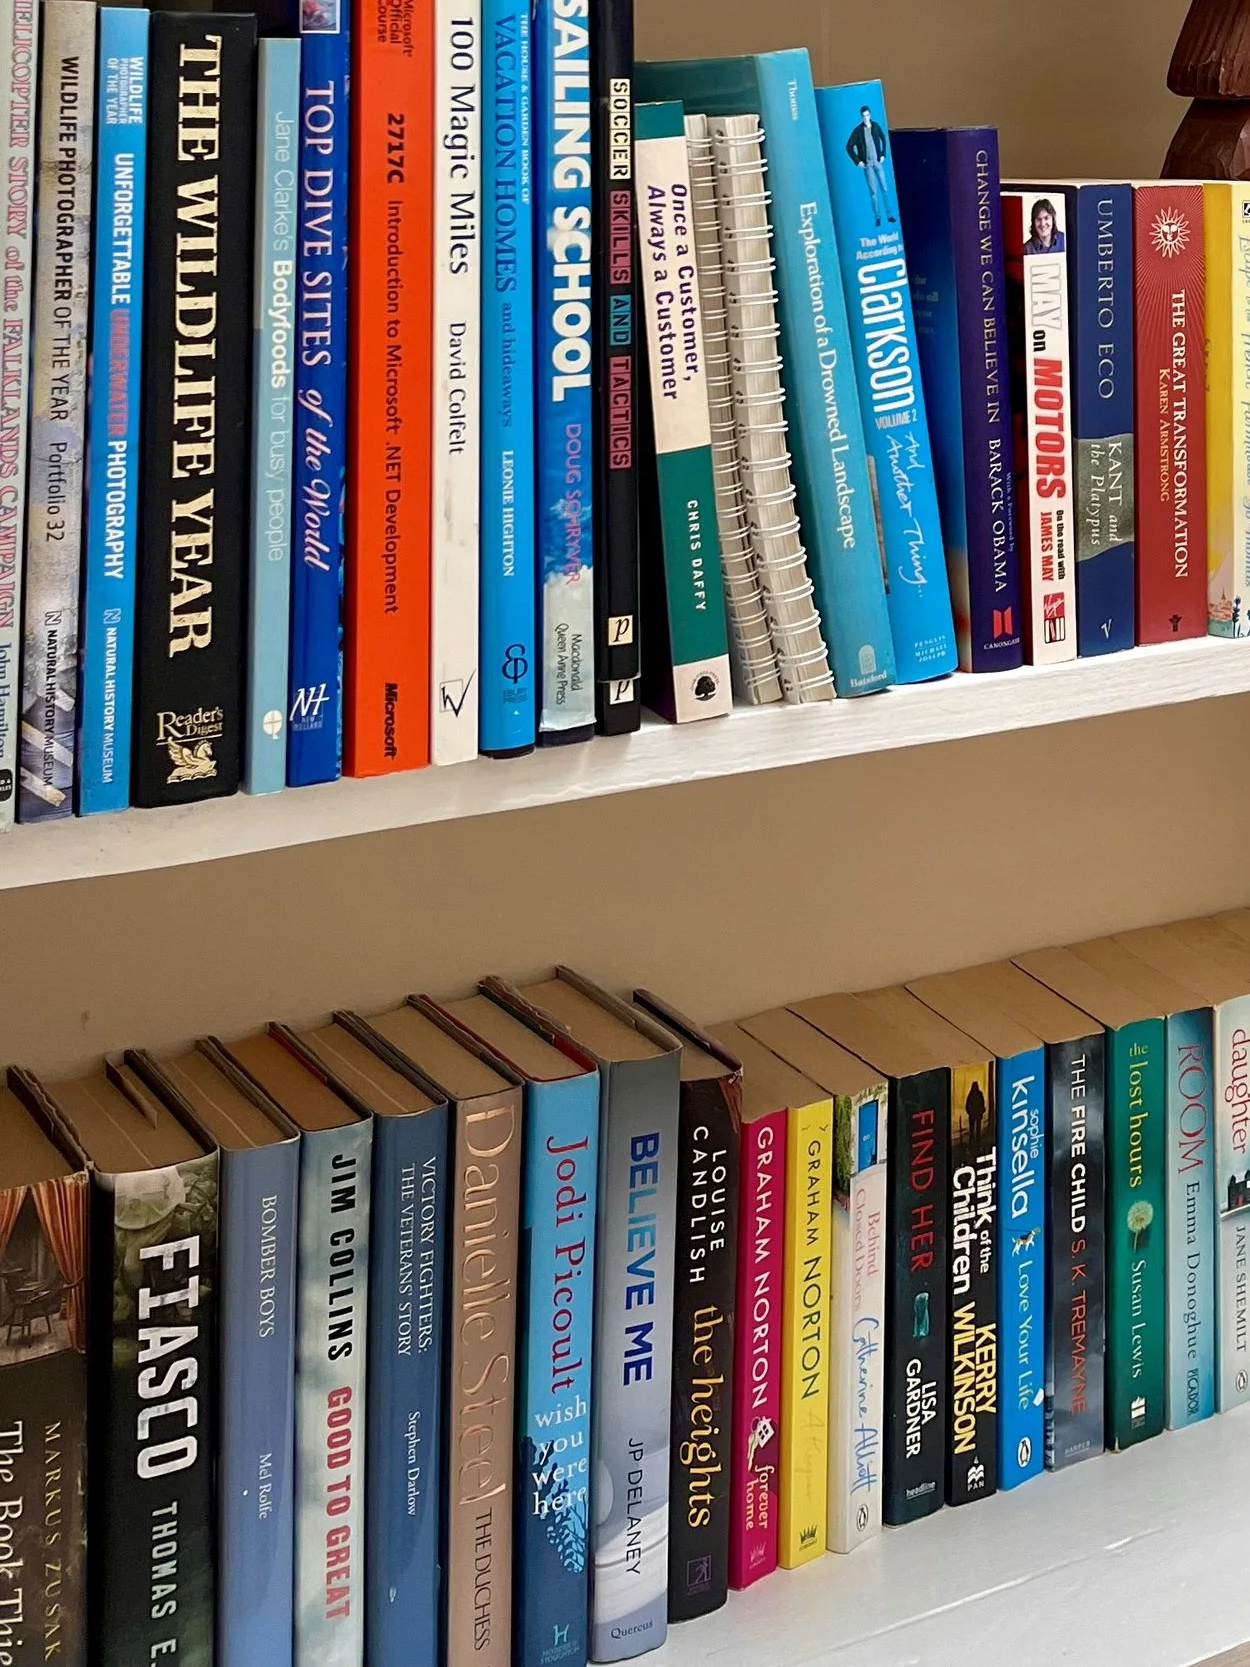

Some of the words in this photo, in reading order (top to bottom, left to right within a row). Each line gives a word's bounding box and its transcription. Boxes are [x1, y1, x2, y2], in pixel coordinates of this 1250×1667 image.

[449, 15, 475, 72] 100
[59, 56, 80, 143] WILDLIFE
[177, 34, 223, 162] THE
[303, 80, 334, 156] TOP
[443, 84, 476, 180] Magic
[611, 79, 630, 179] SOCCER
[385, 111, 406, 185] 2717C
[54, 147, 78, 302] PHOTOGRAPHER
[111, 152, 134, 305] UNFORGETTABLE
[302, 167, 333, 257] DIVE
[448, 191, 477, 275] Miles
[610, 192, 631, 283] SKILLS
[385, 199, 405, 314] Introduction
[1096, 198, 1116, 332] UMBERTO
[172, 173, 219, 480] WILDLIFE
[300, 270, 332, 368] SITES
[385, 315, 401, 337] to
[552, 204, 593, 403] SCHOOL
[610, 297, 631, 346] AND
[857, 258, 916, 413] Clarkson
[1171, 288, 1187, 330] THE
[385, 338, 403, 433] Microsoft
[1098, 341, 1116, 400] ECO
[1171, 331, 1187, 397] GREAT
[610, 356, 631, 468] TACTICS
[48, 440, 67, 513] Portfolio
[384, 439, 402, 485] .NET
[988, 438, 1005, 518] BARACK
[1171, 396, 1190, 580] TRANSFORMATION
[46, 518, 65, 542] 32
[105, 439, 127, 579] PHOTOGRAPHY
[381, 487, 401, 615] Development
[687, 499, 701, 550] CHRIS
[168, 487, 216, 659] YEAR
[690, 557, 707, 611] DAFFY
[991, 519, 1007, 593] OBAMA
[156, 707, 225, 742] Reader's
[185, 721, 224, 738] Digest
[1069, 1055, 1087, 1100] THE
[1127, 1066, 1149, 1103] lost
[1128, 1041, 1149, 1056] the
[1010, 1074, 1036, 1219] kinsella
[1069, 1104, 1087, 1160] FIRE
[1127, 1110, 1149, 1189] hours
[1176, 1043, 1209, 1175] ROOM
[330, 1154, 357, 1215] JIM
[546, 1135, 590, 1227] Jodi
[910, 1109, 935, 1194] FIND
[622, 1131, 661, 1313] BELIEVE
[753, 1126, 775, 1267] GRAHAM
[1069, 1164, 1087, 1233] CHILD
[910, 1206, 935, 1274] HER
[327, 1227, 356, 1362] COLLINS
[550, 1242, 588, 1395] Picoult
[1130, 1258, 1147, 1321] Susan
[135, 1234, 200, 1481] FIASCO
[622, 1321, 654, 1387] ME
[750, 1280, 772, 1410] NORTON
[1130, 1324, 1144, 1380] Lewis
[325, 1385, 354, 1469] GOOD
[325, 1475, 351, 1517] TO
[324, 1523, 351, 1621] GREAT
